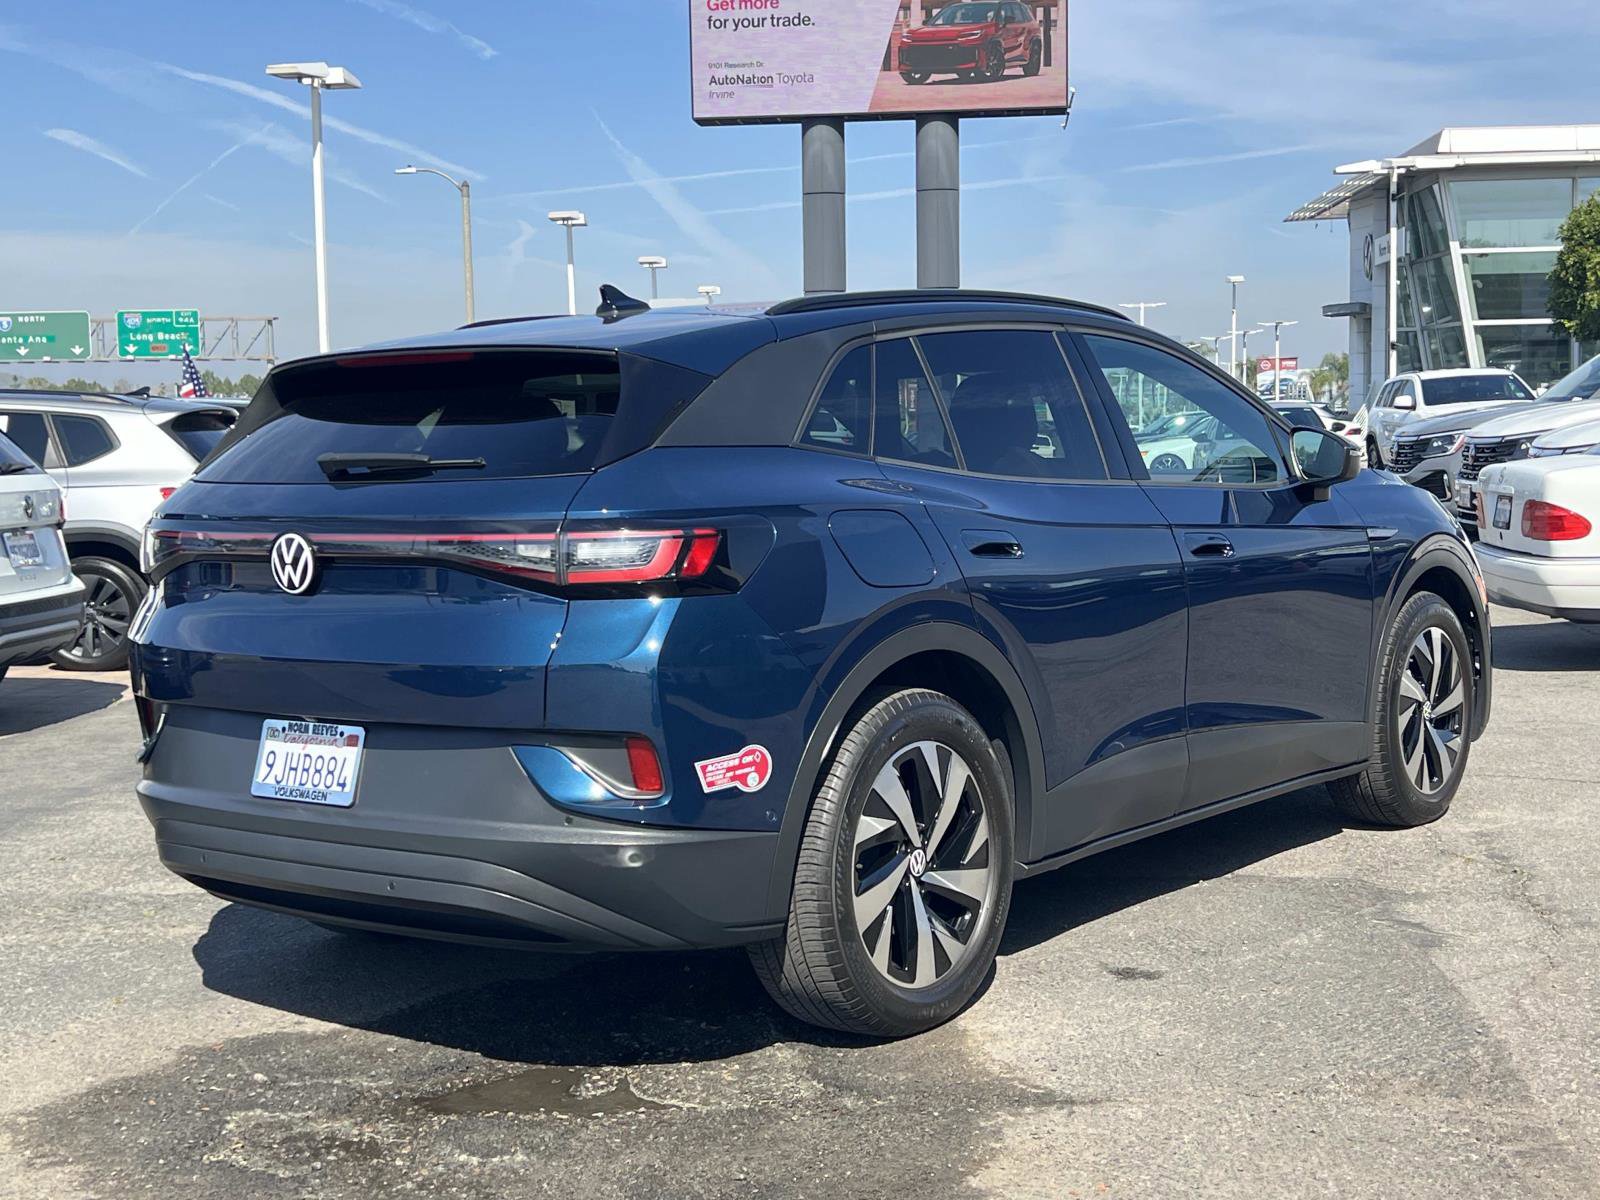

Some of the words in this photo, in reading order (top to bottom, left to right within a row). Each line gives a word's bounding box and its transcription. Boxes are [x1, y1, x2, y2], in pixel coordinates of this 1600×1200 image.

[707, 0, 735, 11] Get
[738, 0, 780, 10] more
[707, 15, 729, 29] for
[732, 16, 767, 32] your
[770, 12, 815, 28] trade.
[724, 61, 755, 69] Research
[709, 74, 774, 86] AutoNation
[776, 72, 814, 86] Toyota
[708, 90, 735, 99] Irvine
[17, 315, 46, 323] NORTH
[2, 320, 9, 330] 5
[0, 335, 24, 344] anta
[27, 335, 47, 344] Ana
[129, 332, 154, 343] Long
[287, 721, 310, 734] NORM
[312, 723, 339, 737] REEVES
[262, 750, 347, 792] 9JHB884
[274, 786, 328, 801] VOLKSWAGEN
